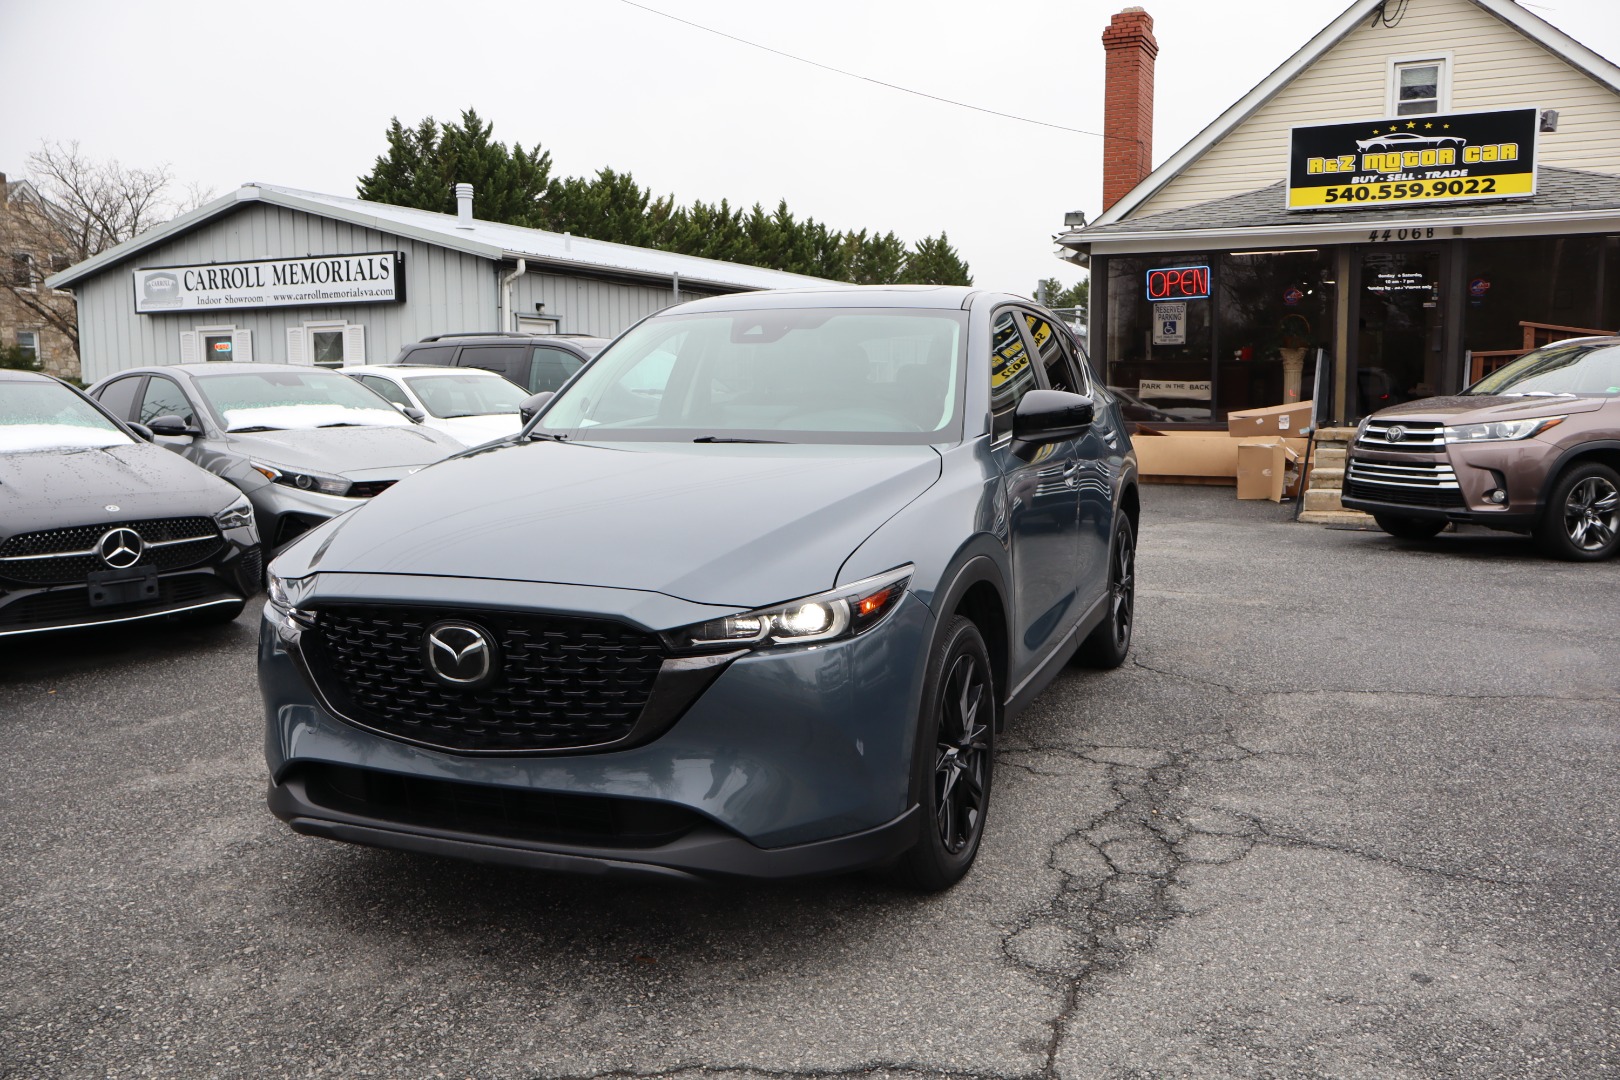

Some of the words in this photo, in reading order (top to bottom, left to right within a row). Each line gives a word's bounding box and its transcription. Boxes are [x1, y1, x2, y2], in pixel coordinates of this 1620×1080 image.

[1307, 155, 1356, 174] R&Z
[1351, 175, 1378, 184] BUY
[1386, 173, 1415, 182] SELL
[1425, 169, 1469, 179] TRADE
[1325, 178, 1496, 203] 540.559.9022
[184, 266, 265, 292] CARROLL
[272, 257, 390, 287] MEMORIALS
[1149, 268, 1207, 297] OPEN
[197, 296, 221, 305] Indoor
[224, 294, 264, 304] Showroom
[273, 287, 393, 301] www.carrollmemorialsva.com
